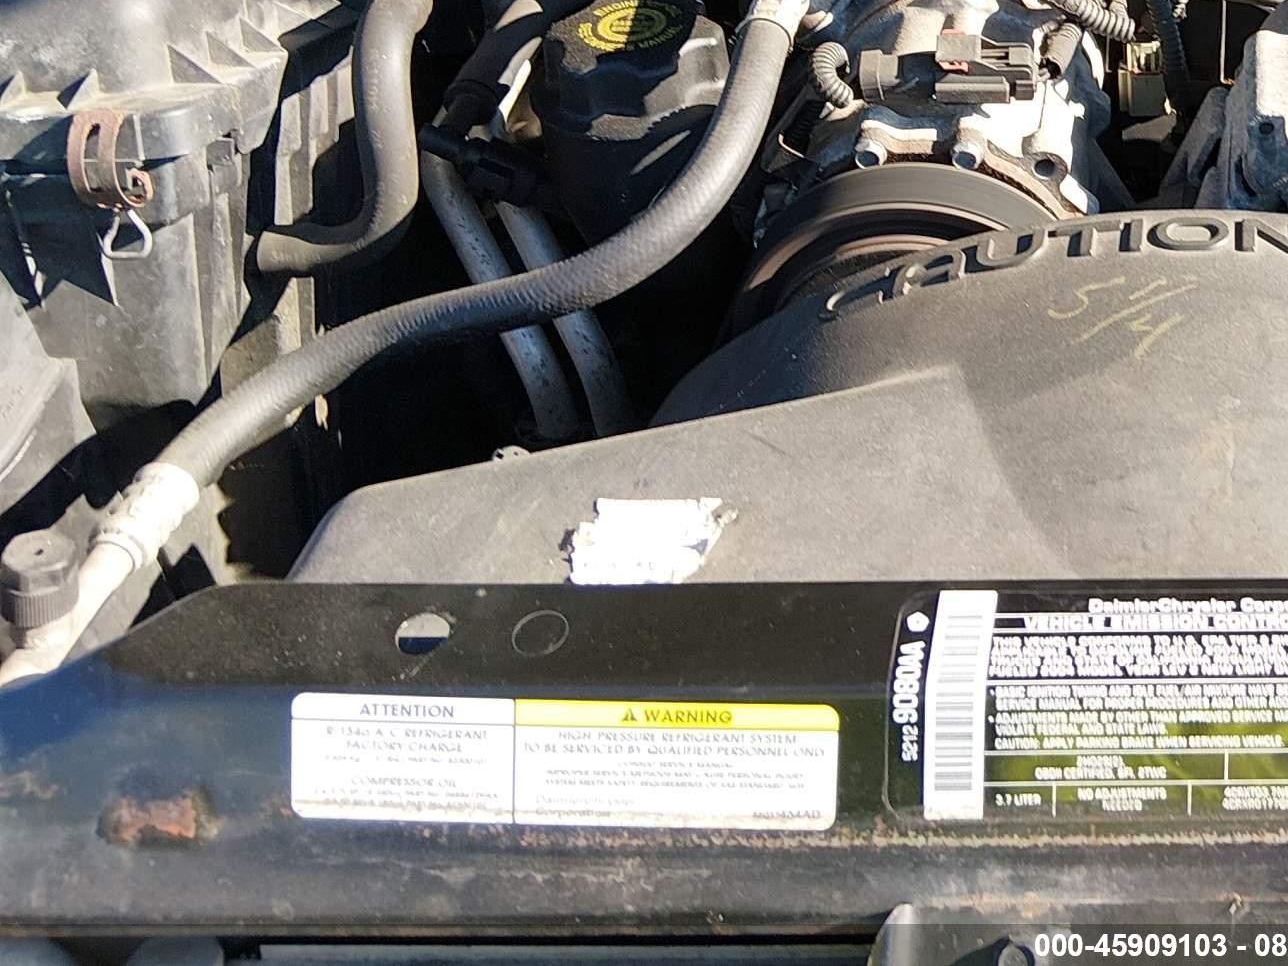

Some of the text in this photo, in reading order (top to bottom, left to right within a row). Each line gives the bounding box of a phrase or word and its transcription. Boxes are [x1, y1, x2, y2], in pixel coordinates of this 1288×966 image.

[1089, 597, 1236, 613] DaimlerChrysler
[1025, 616, 1104, 628] VEHICLE
[1109, 616, 1207, 628] EMISSION
[360, 703, 455, 718] ATTENTION
[644, 709, 733, 724] WARNING
[597, 732, 656, 743] PRESSURE
[661, 732, 745, 744] REFRIGERANT
[749, 734, 798, 745] SYSTEM
[408, 742, 463, 753] CHARGE
[544, 744, 557, 754] BE
[562, 743, 624, 755] SERVICED
[627, 745, 642, 755] BY
[716, 745, 789, 757] PERSONNEL
[1014, 794, 1042, 806] LITER
